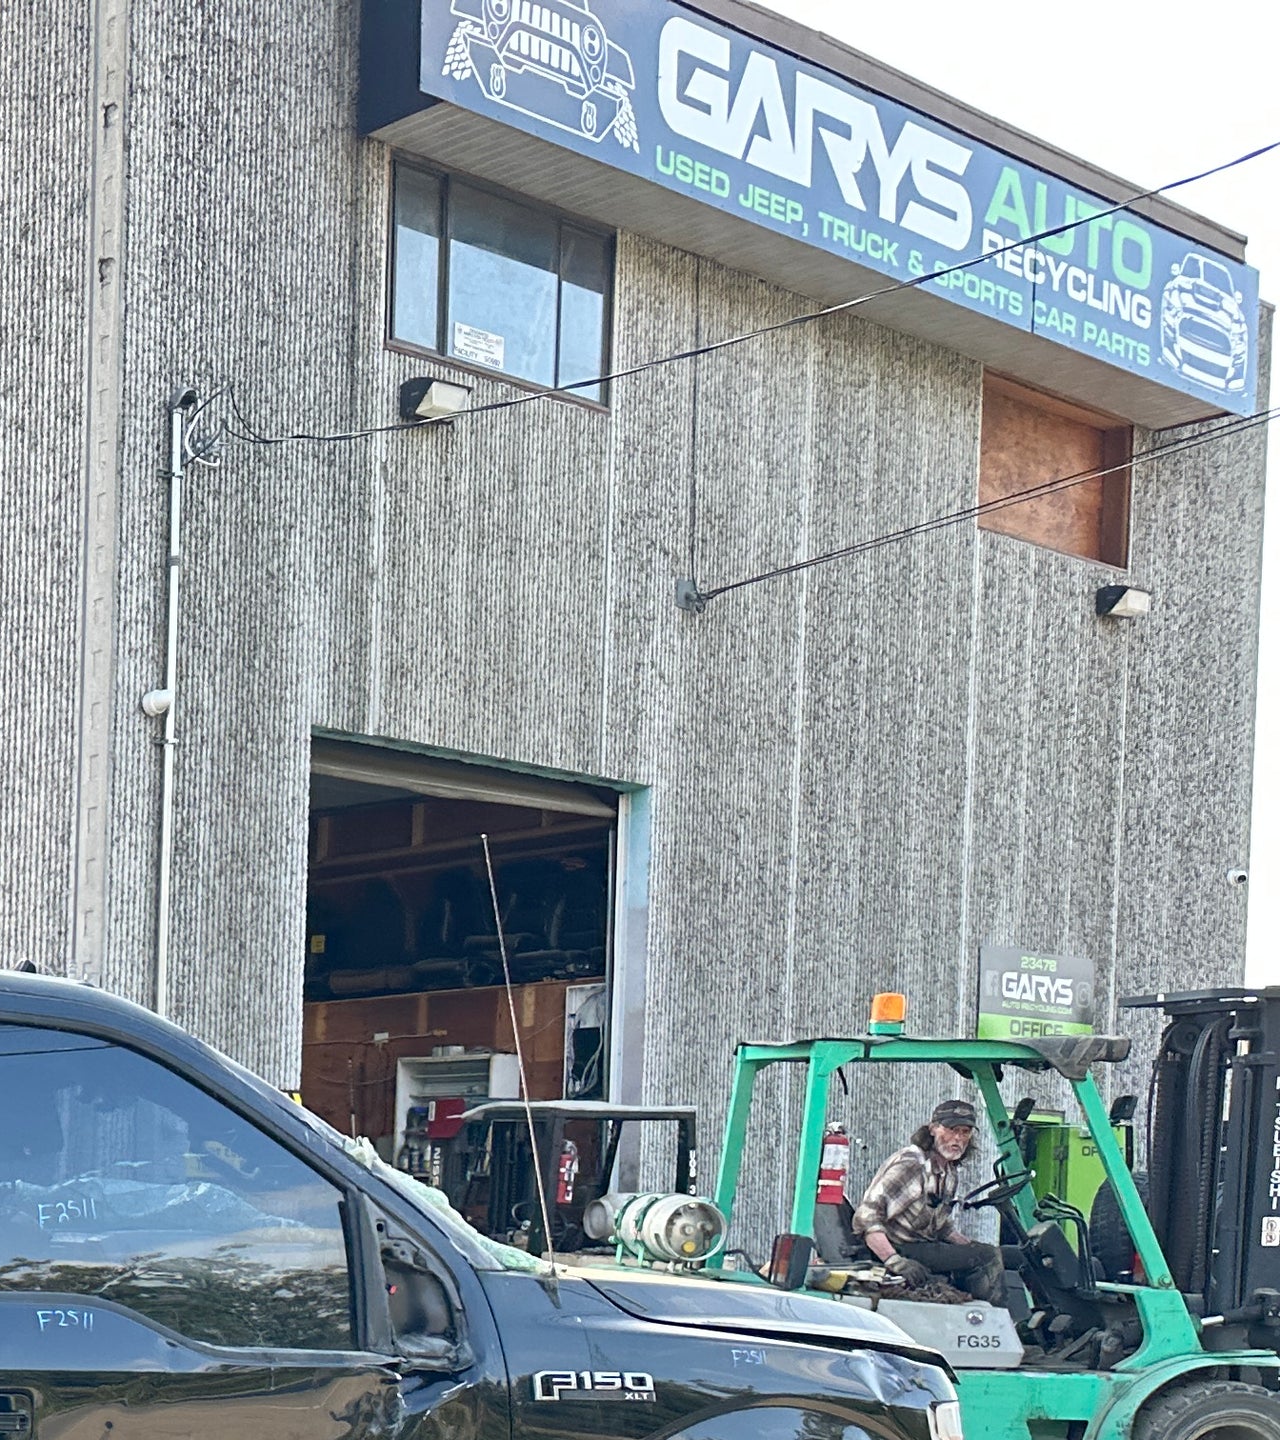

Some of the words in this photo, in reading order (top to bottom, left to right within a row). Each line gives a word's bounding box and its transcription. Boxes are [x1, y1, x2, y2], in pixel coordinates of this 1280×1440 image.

[659, 15, 973, 252] GARYS
[984, 165, 1153, 291] AUTO
[655, 144, 731, 199] USED
[739, 183, 809, 237] JEEP,
[817, 211, 899, 267] TRUCK
[907, 249, 925, 277] &
[933, 259, 1024, 317] SPORTS
[1033, 300, 1077, 338] CAR
[1082, 320, 1151, 367] PARTS
[981, 228, 1153, 330] RECYCLING
[1020, 956, 1058, 972] 23478
[1001, 971, 1074, 1006] GARYS
[1009, 1019, 1064, 1037] OFFICE
[37, 1197, 97, 1229] F2511
[37, 1309, 94, 1333] F2511
[957, 1334, 1001, 1348] FG35
[532, 1370, 655, 1401] F150
[623, 1391, 650, 1400] XLT
